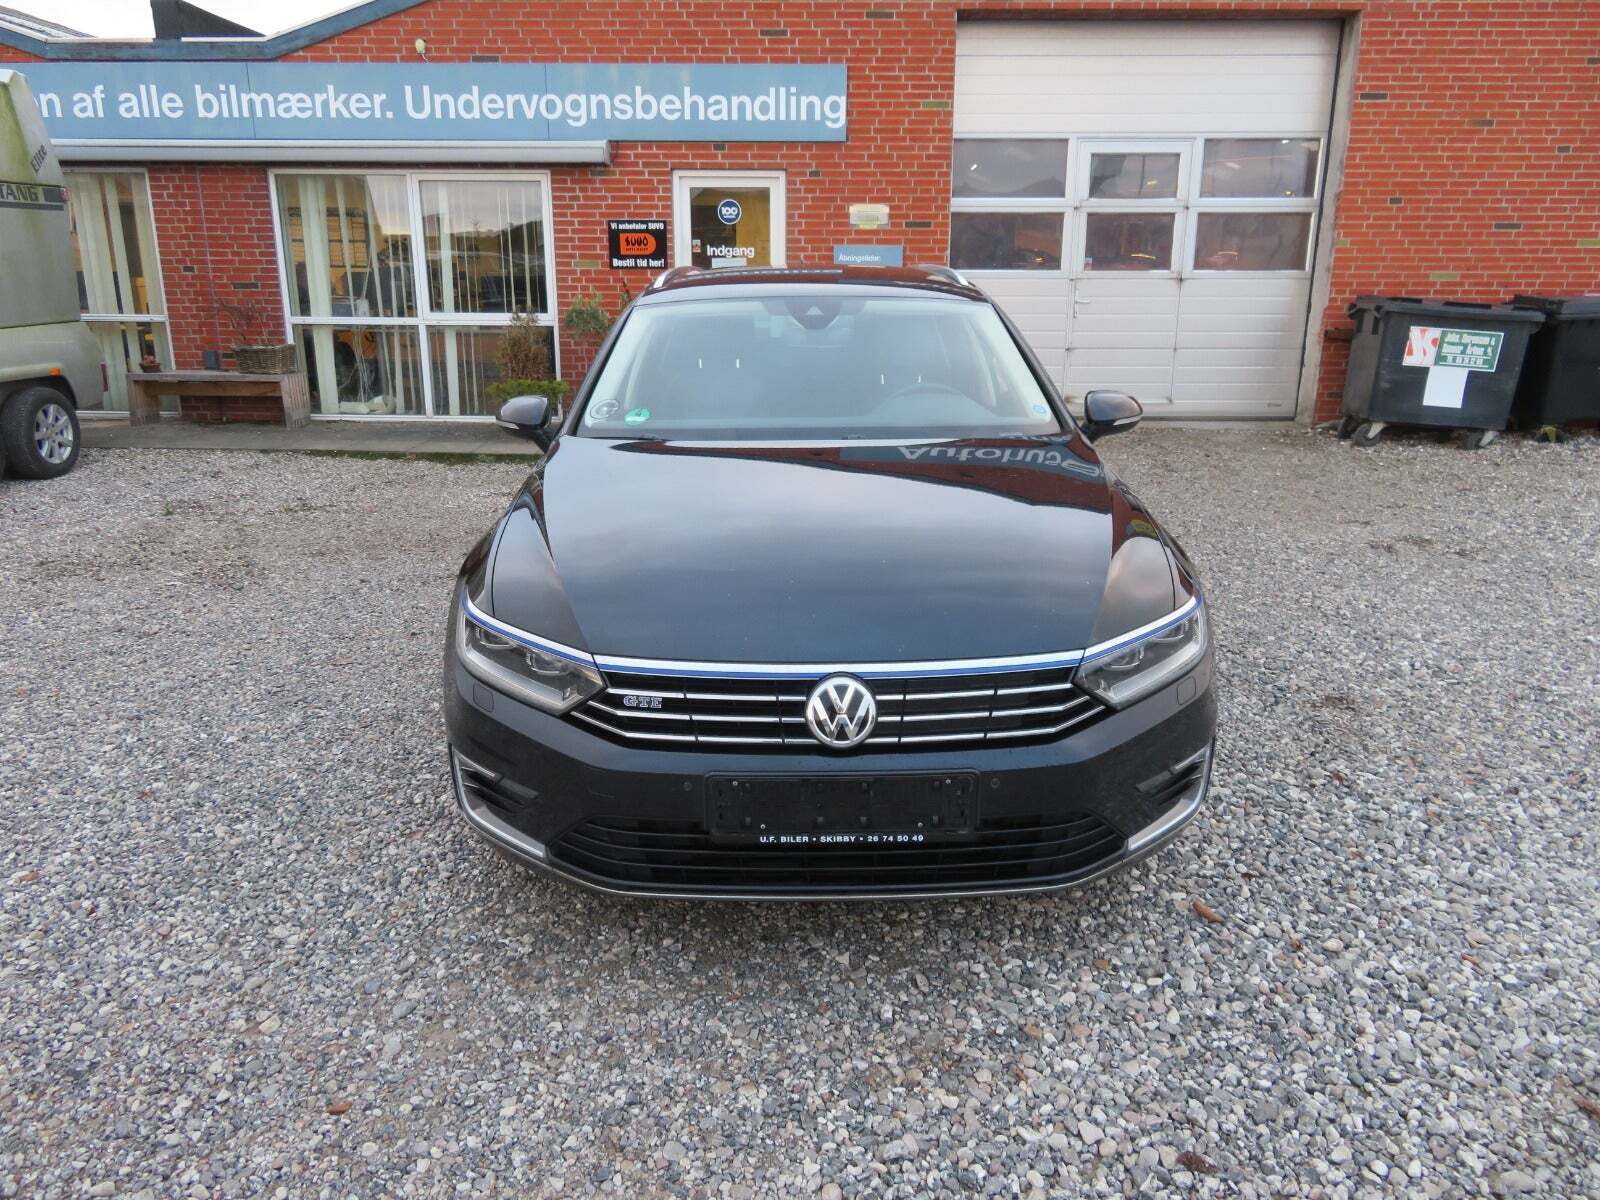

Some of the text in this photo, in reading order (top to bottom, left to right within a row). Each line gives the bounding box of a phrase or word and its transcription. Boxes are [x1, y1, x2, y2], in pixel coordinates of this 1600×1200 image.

[34, 85, 847, 128] n af alle bilmærker. Undervognsbehandling
[721, 206, 739, 215] 100
[707, 245, 755, 257] Indgang
[637, 258, 647, 267] tid
[624, 695, 662, 709] GTE
[810, 679, 874, 745] VW
[820, 835, 856, 843] SKIBBY
